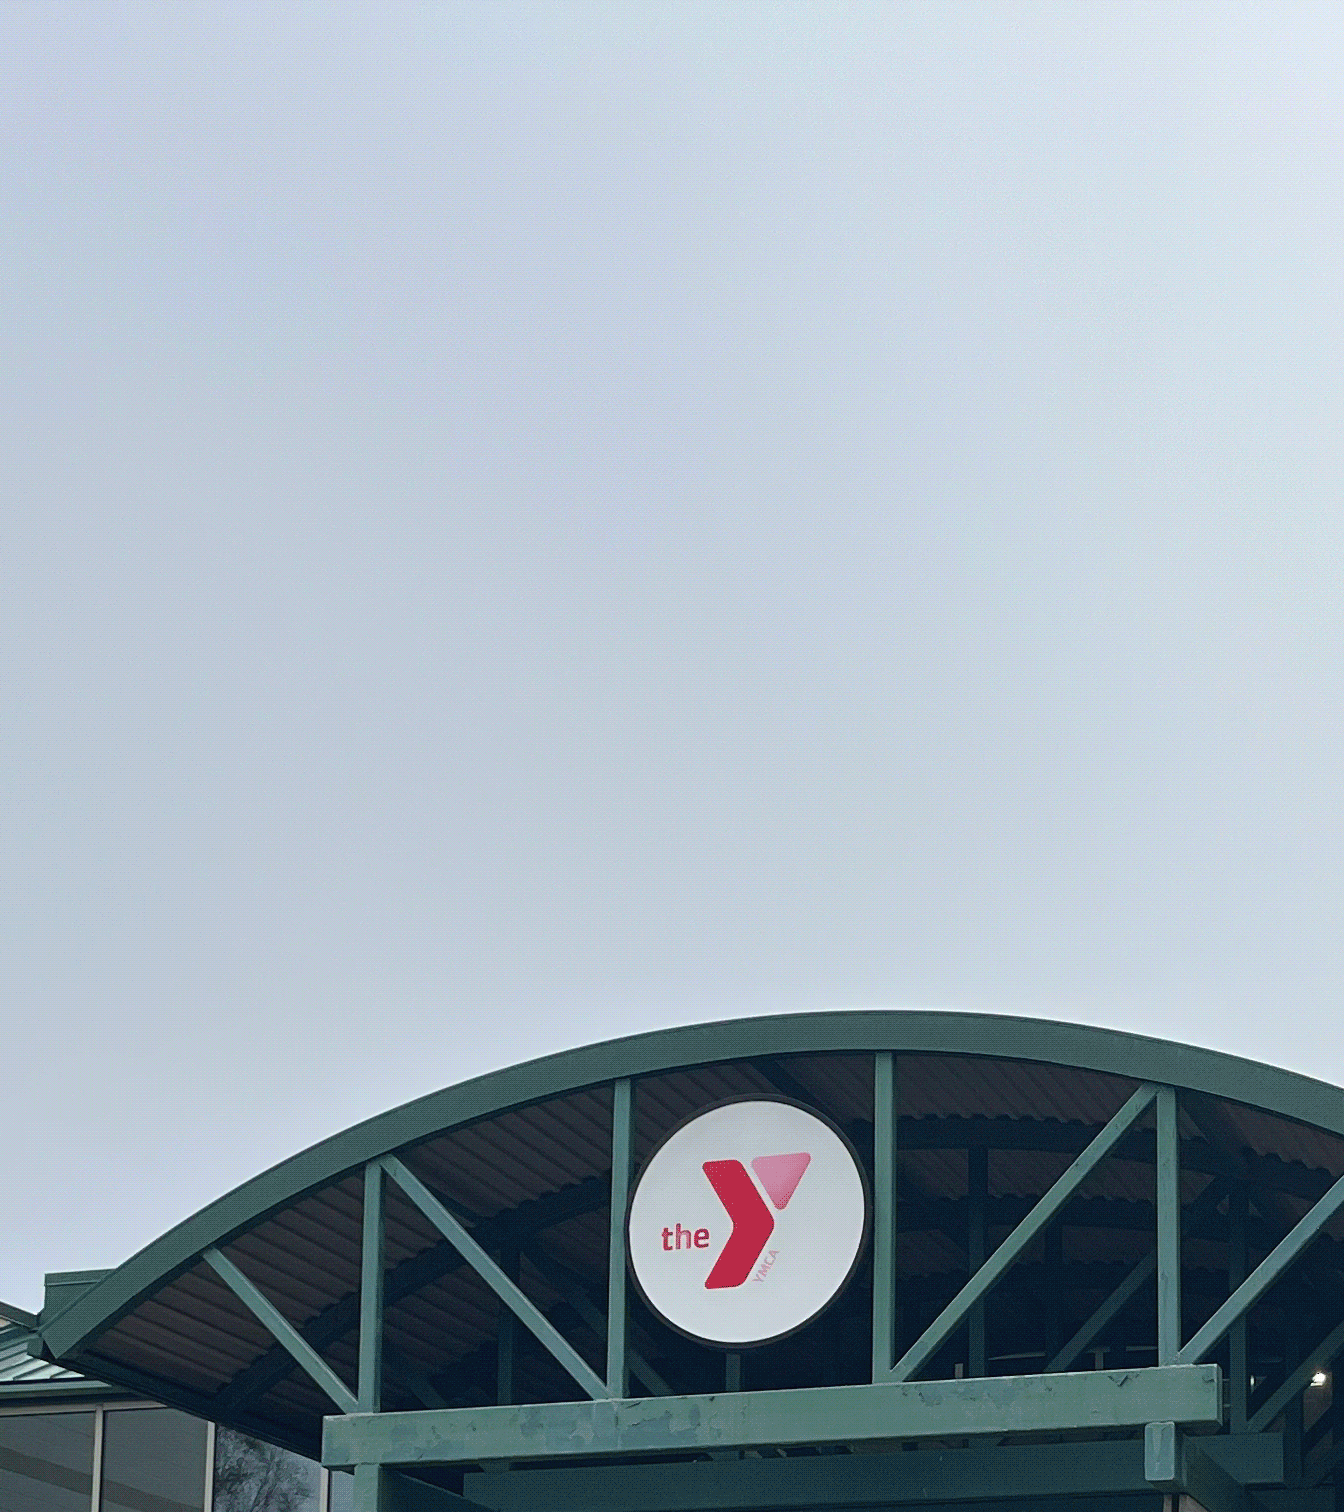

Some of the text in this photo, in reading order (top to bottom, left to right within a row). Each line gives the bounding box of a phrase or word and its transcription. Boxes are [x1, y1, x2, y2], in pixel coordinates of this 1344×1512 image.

[661, 1152, 812, 1290] the Y
[752, 1249, 780, 1285] YMCA
